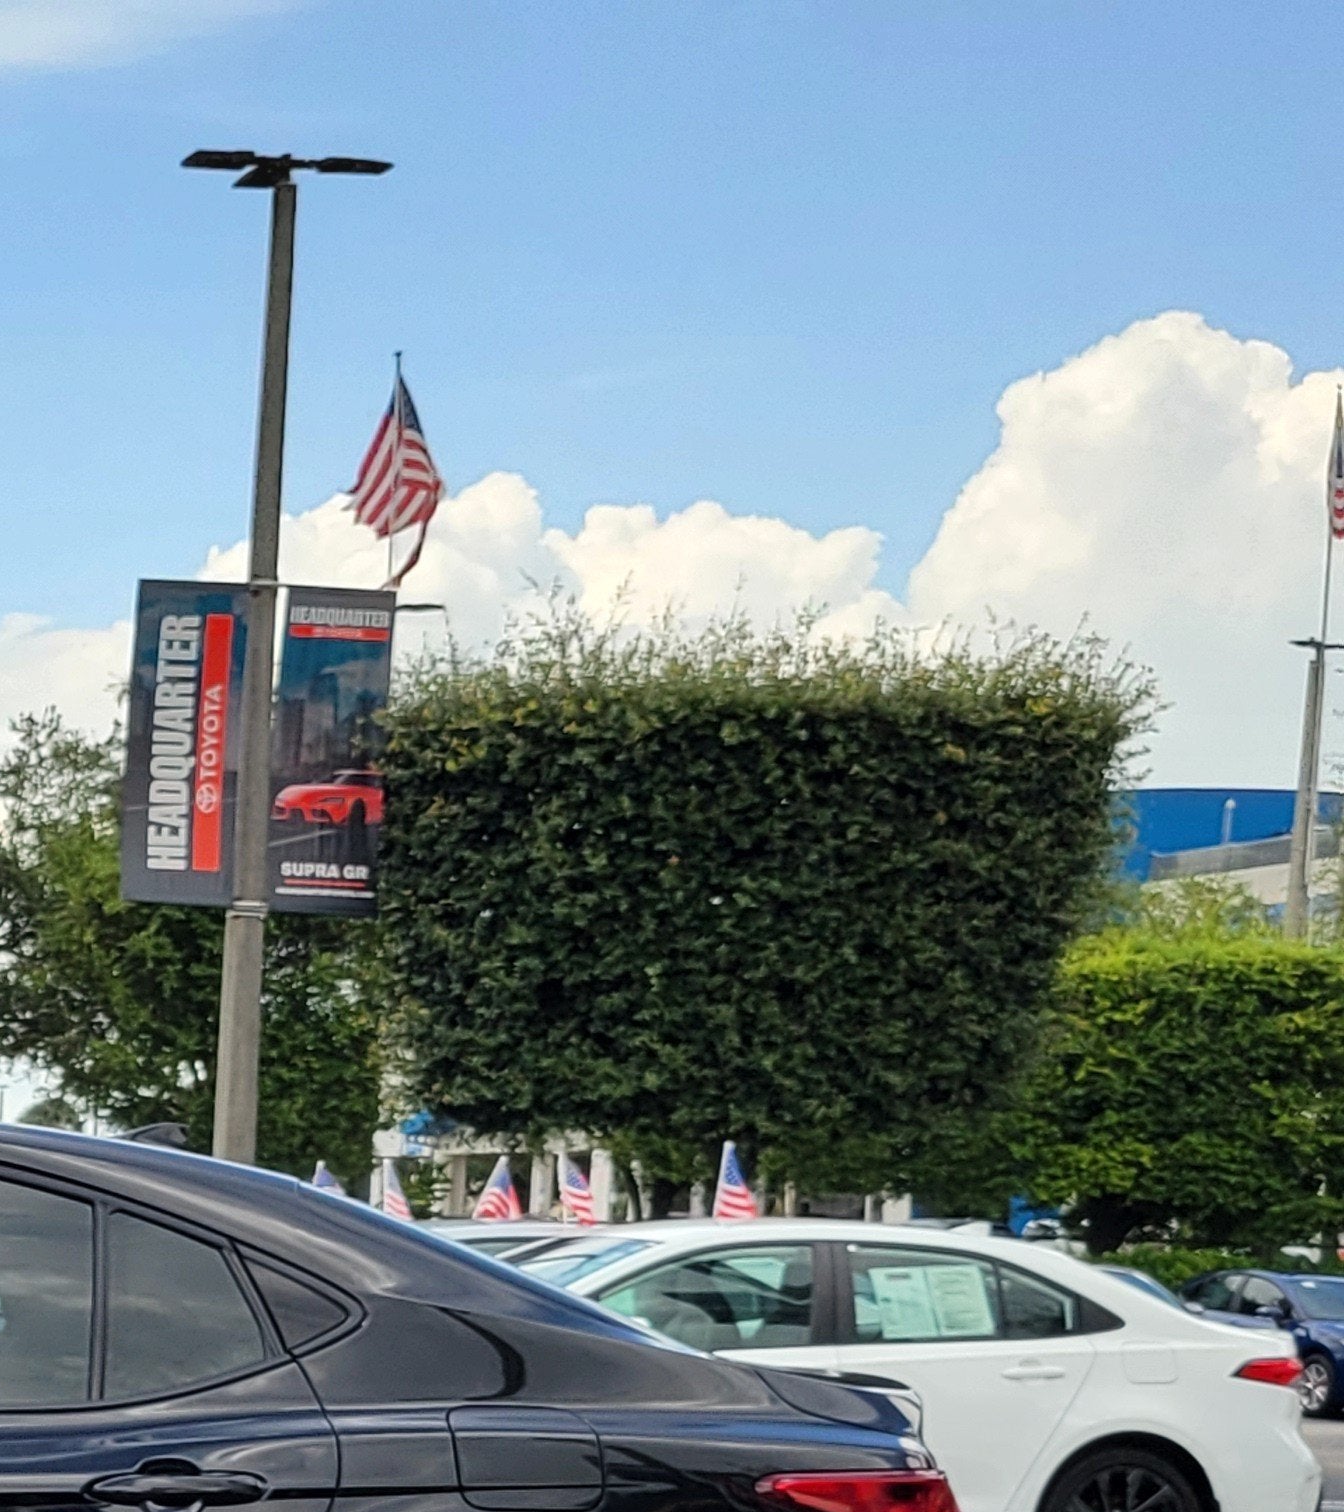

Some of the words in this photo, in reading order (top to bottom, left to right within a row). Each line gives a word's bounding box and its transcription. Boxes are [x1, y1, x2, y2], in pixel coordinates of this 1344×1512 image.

[290, 606, 389, 628] HEADQUARTER
[146, 614, 202, 870] HEADQUARTER
[199, 684, 223, 779] TOYOTA
[281, 862, 340, 878] SUPRA
[343, 865, 369, 880] GR
